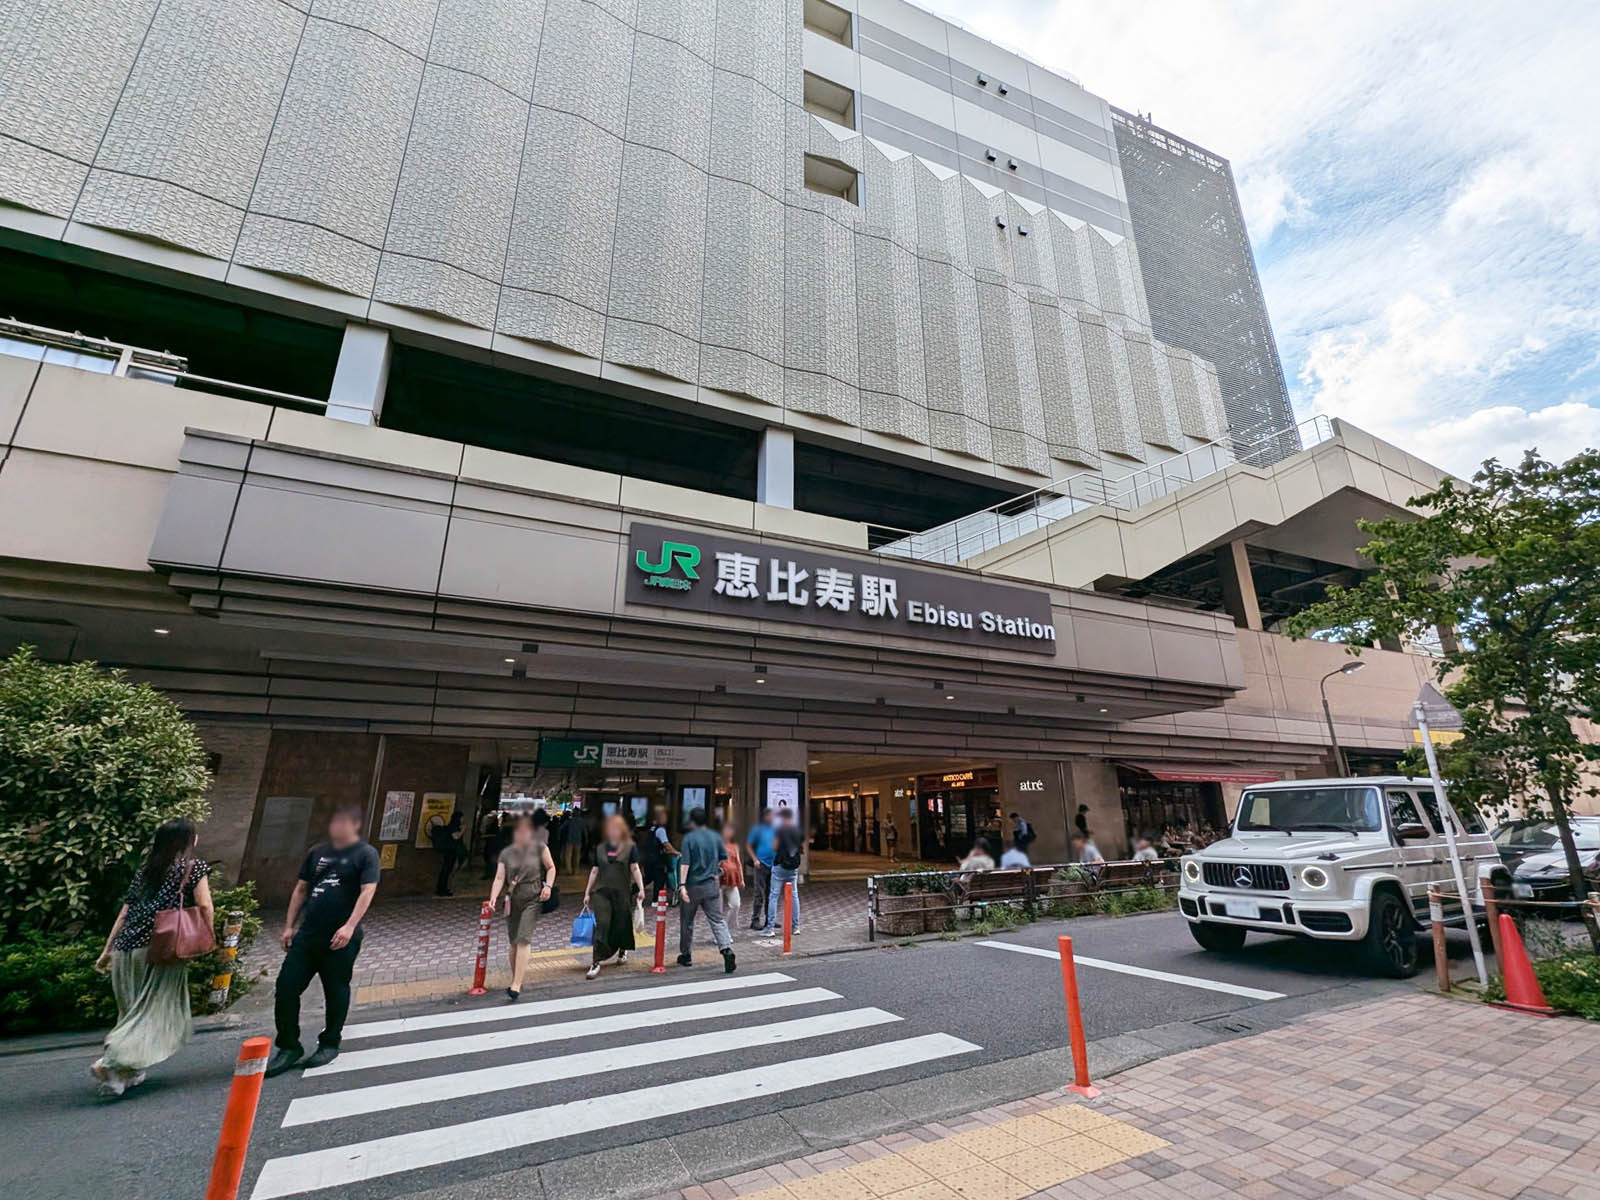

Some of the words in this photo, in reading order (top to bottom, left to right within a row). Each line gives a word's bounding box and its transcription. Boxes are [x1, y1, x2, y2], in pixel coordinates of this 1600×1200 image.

[636, 541, 701, 579] JR
[713, 551, 899, 619] 恵比寿駅
[908, 600, 973, 629] Ebisu
[979, 611, 1056, 640] Station
[573, 745, 600, 760] JR
[606, 746, 649, 758] 恵比寿駅
[1019, 779, 1045, 791] atré
